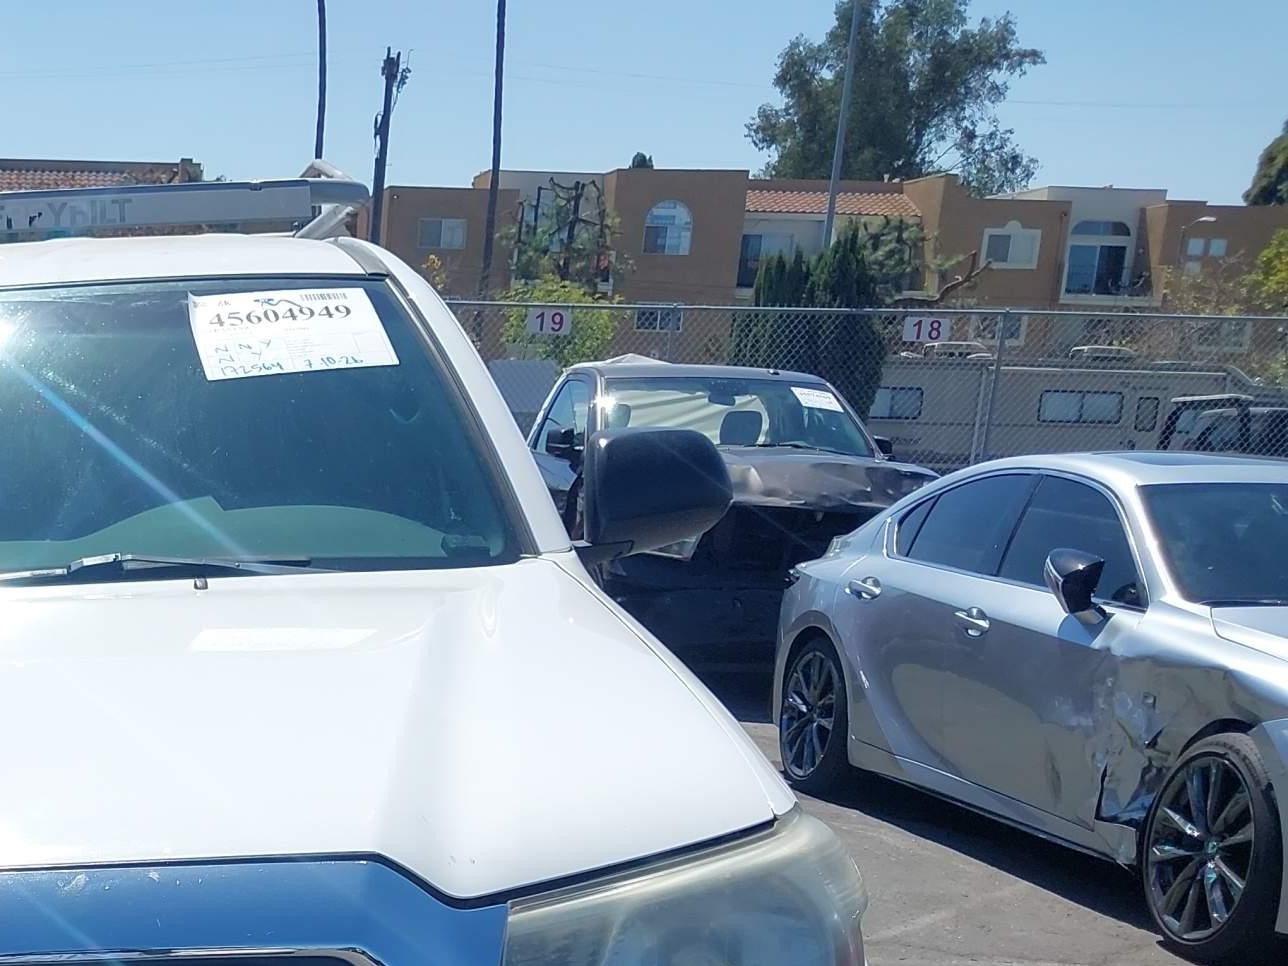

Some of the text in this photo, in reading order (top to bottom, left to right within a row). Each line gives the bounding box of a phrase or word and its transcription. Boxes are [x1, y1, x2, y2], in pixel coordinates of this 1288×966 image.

[209, 304, 352, 327] 45604949
[535, 311, 564, 332] 19
[913, 319, 942, 340] 18
